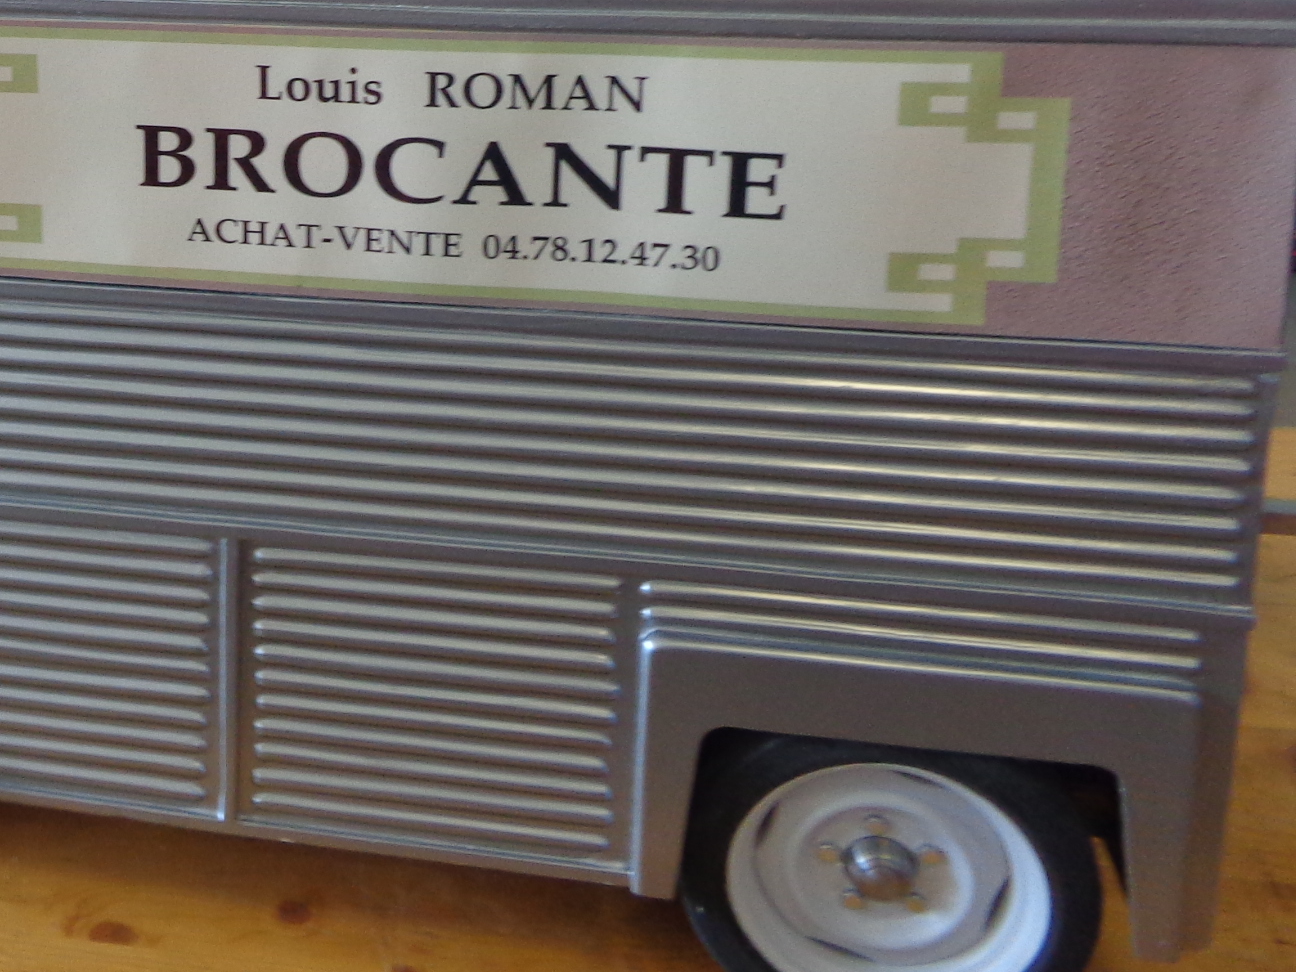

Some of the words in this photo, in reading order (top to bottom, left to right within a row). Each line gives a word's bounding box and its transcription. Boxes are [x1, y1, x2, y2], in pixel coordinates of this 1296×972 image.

[255, 64, 384, 106] Louis
[423, 71, 649, 114] ROMAN
[135, 124, 787, 221] BROCANTE
[186, 217, 464, 259] ACHAT-VENTE
[481, 233, 722, 272] 04.78.12.47.30
